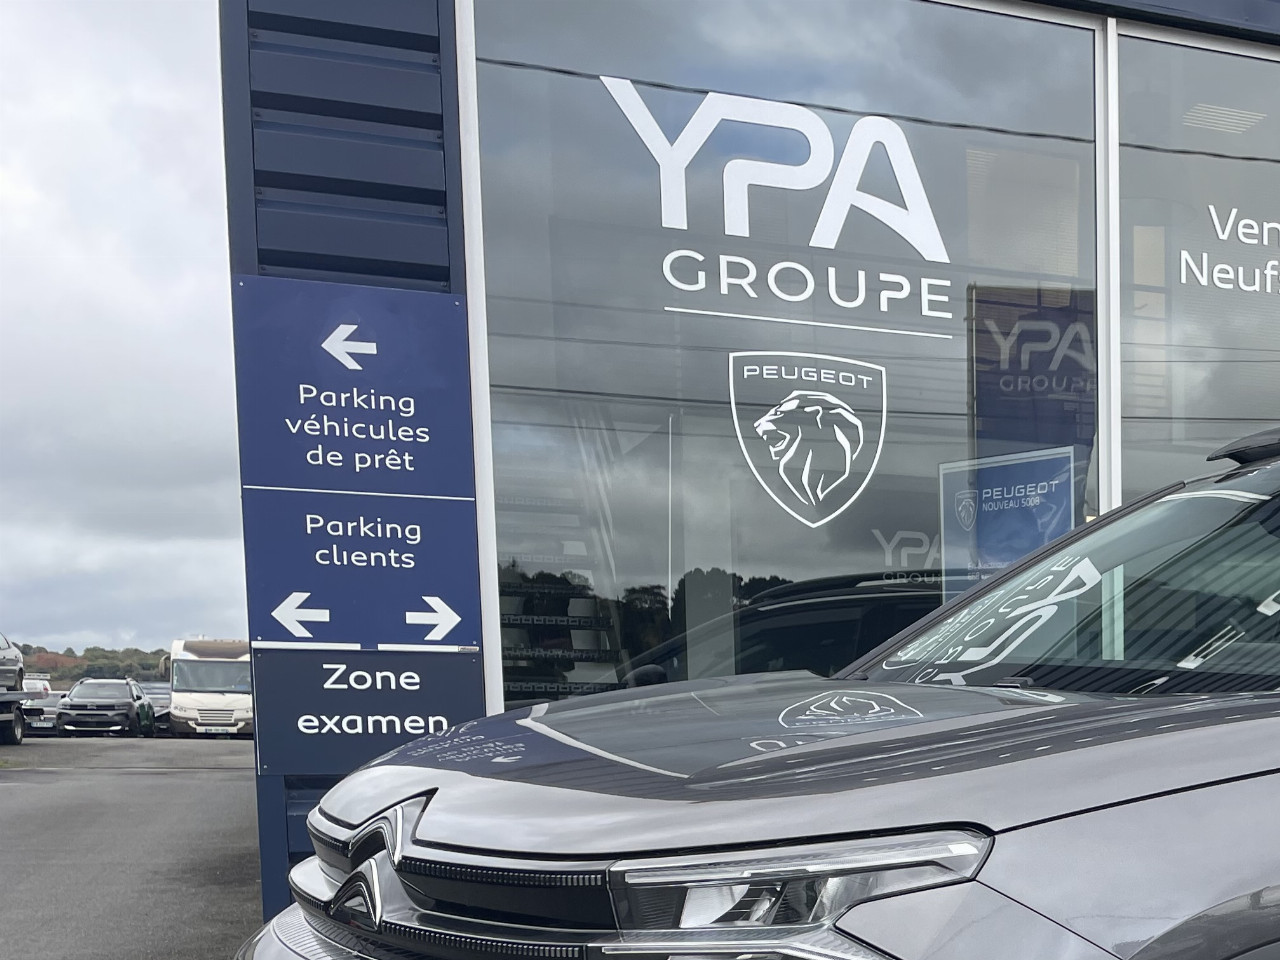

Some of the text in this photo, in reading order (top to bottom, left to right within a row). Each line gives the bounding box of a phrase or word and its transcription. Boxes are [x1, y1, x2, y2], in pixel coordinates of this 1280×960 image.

[599, 75, 951, 264] YPA
[661, 249, 953, 319] GROUPE
[983, 318, 1097, 375] YPA
[743, 365, 873, 389] PEUGEOT
[299, 384, 416, 418] Parking
[285, 415, 430, 444] véhicules
[306, 444, 415, 472] de prêt
[982, 480, 1059, 500] PEUGEOT
[982, 496, 1041, 511] NOUVEAU 5008
[306, 514, 422, 545] Parking
[315, 545, 416, 569] clients
[322, 663, 421, 691] Zone
[297, 711, 449, 735] examen
